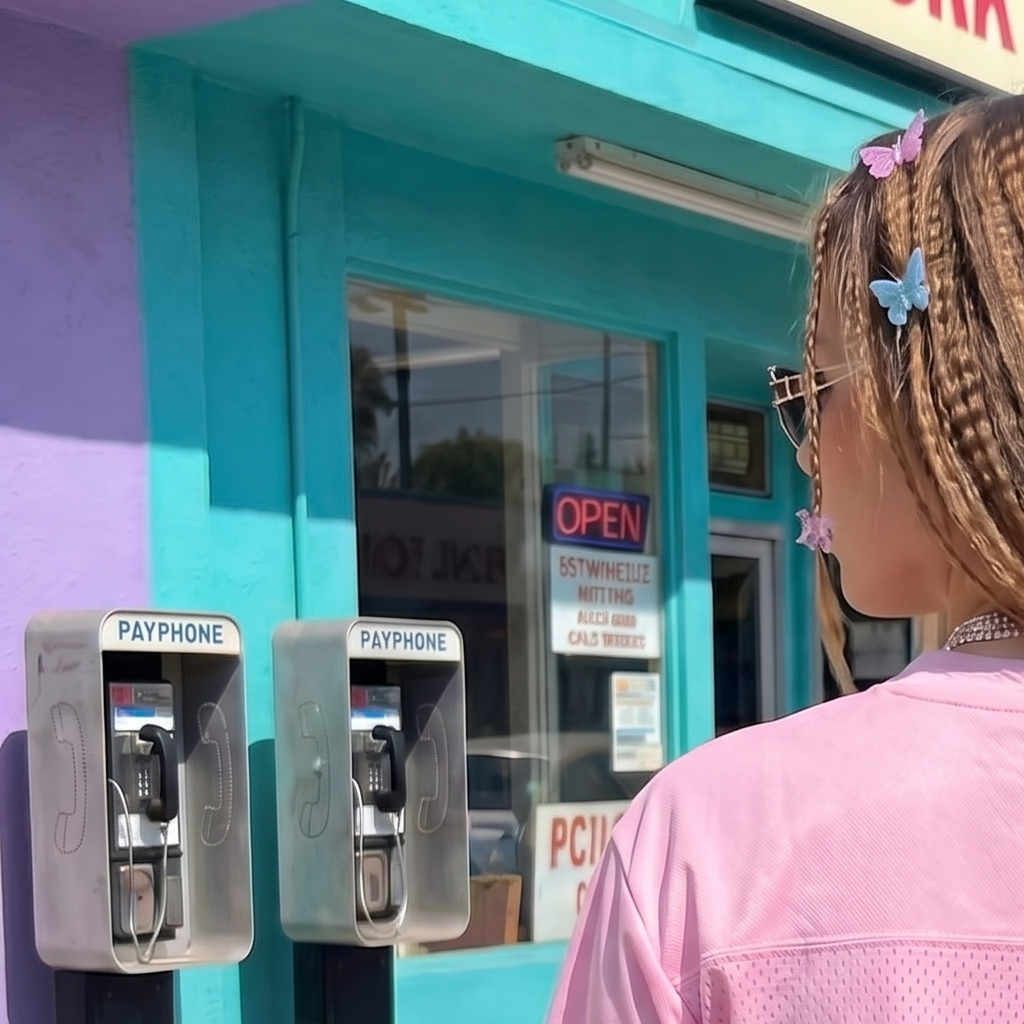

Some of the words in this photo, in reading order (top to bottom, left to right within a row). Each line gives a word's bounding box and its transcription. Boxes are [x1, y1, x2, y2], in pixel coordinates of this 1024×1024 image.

[556, 496, 641, 542] OPEN
[118, 619, 224, 645] PAYPHONE
[360, 629, 448, 652] PAYPHONE
